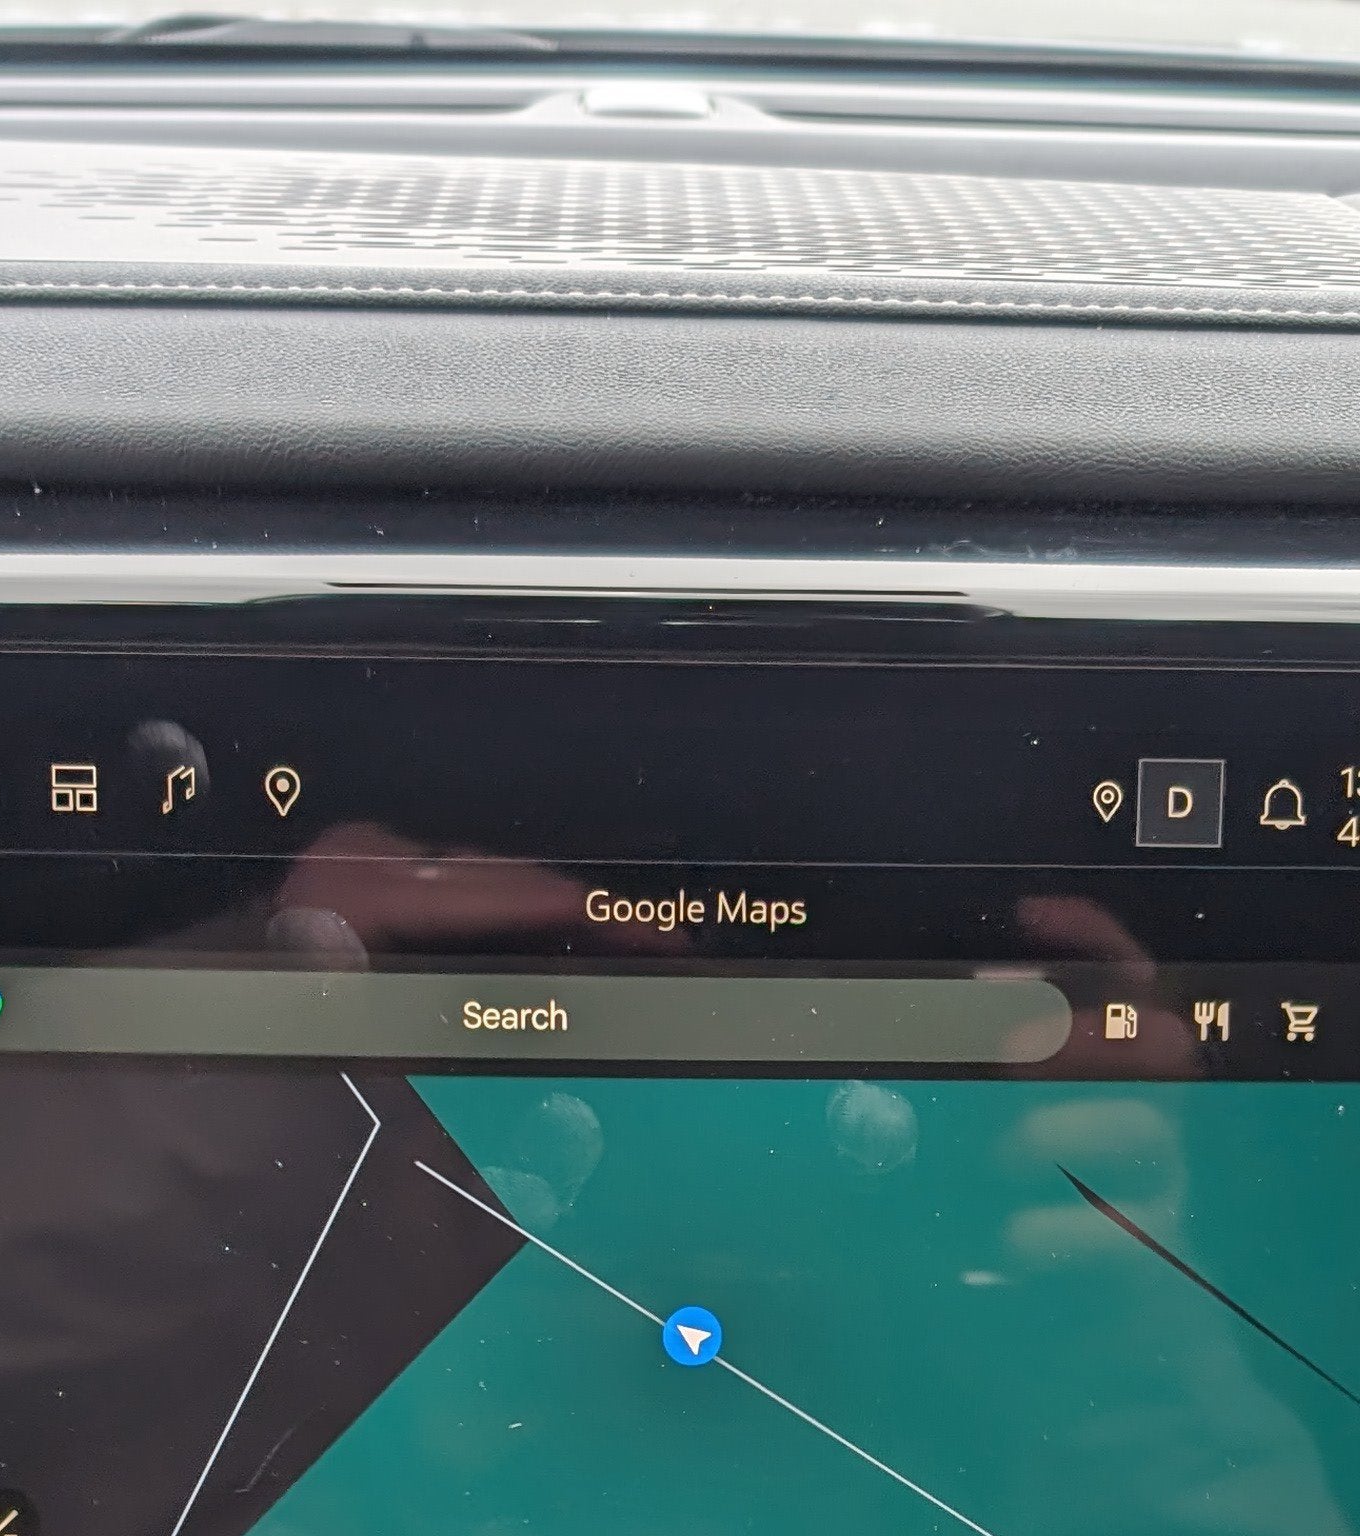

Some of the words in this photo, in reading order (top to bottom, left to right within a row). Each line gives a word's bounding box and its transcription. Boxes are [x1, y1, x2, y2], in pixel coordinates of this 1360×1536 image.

[1167, 786, 1193, 819] D
[585, 889, 705, 932] Google
[717, 891, 807, 933] Maps
[463, 999, 568, 1031] Search
